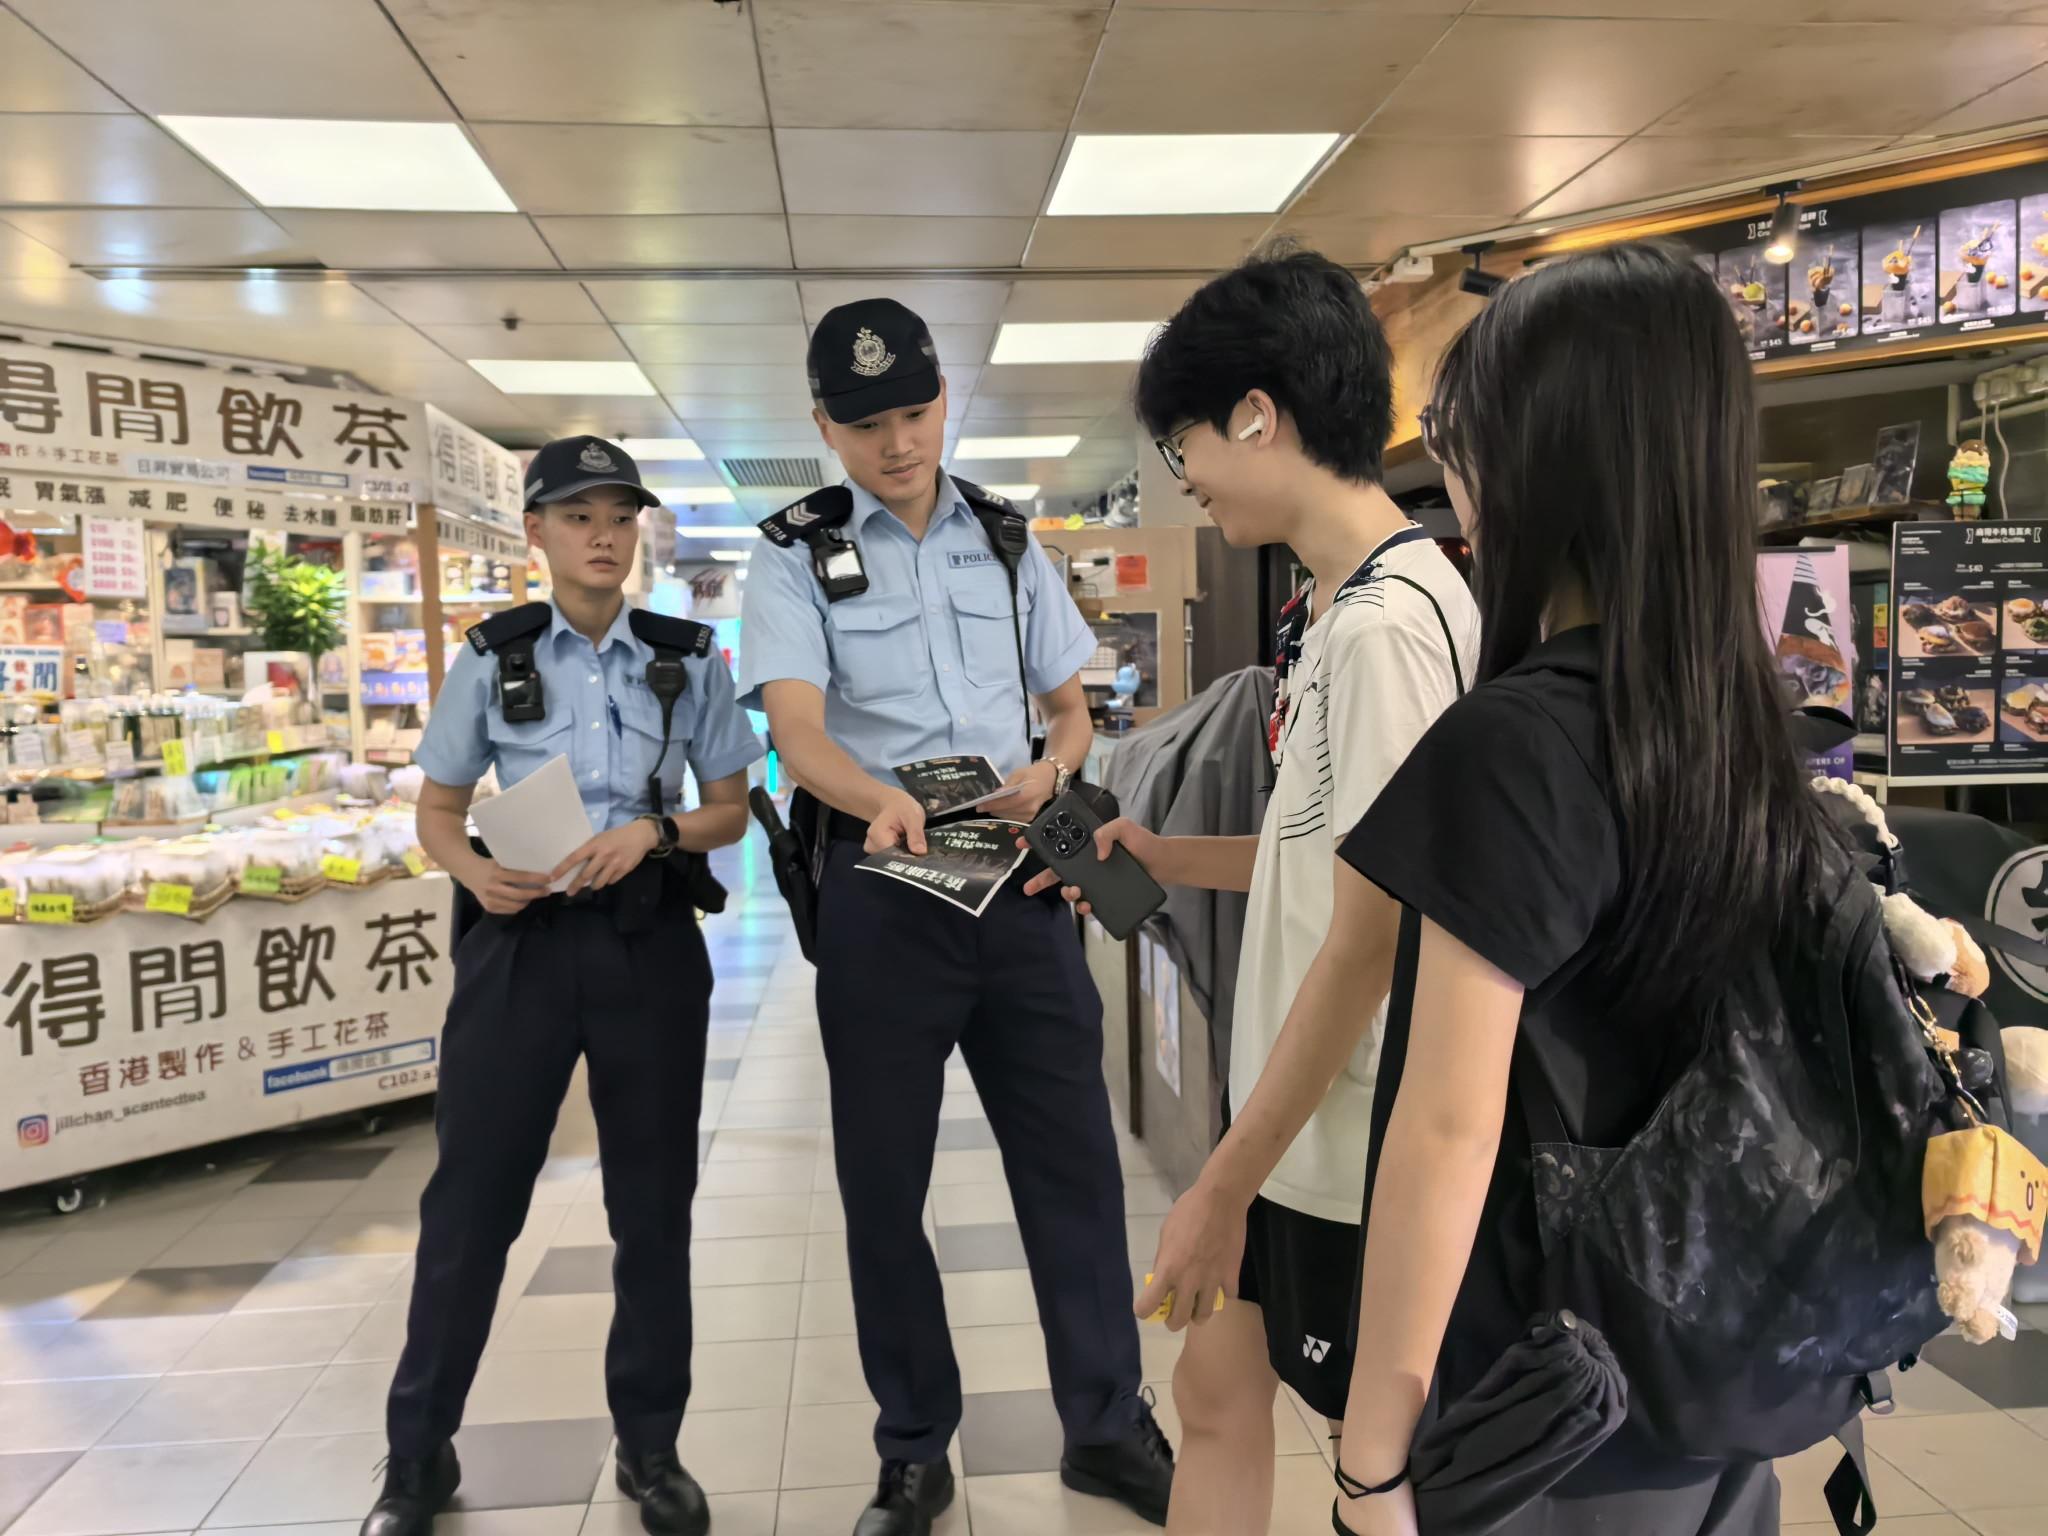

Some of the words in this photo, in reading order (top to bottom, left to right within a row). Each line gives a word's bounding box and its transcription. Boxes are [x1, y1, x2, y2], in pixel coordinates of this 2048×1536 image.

[1, 909, 439, 1056] 得閒飲茶
[79, 1042, 225, 1096] 香港製作
[238, 1036, 256, 1060] &
[267, 1011, 390, 1060] 手工花茶
[267, 1067, 327, 1089] facebook
[378, 1070, 419, 1090] C102
[55, 1091, 206, 1134] jillchan_scentedtea
